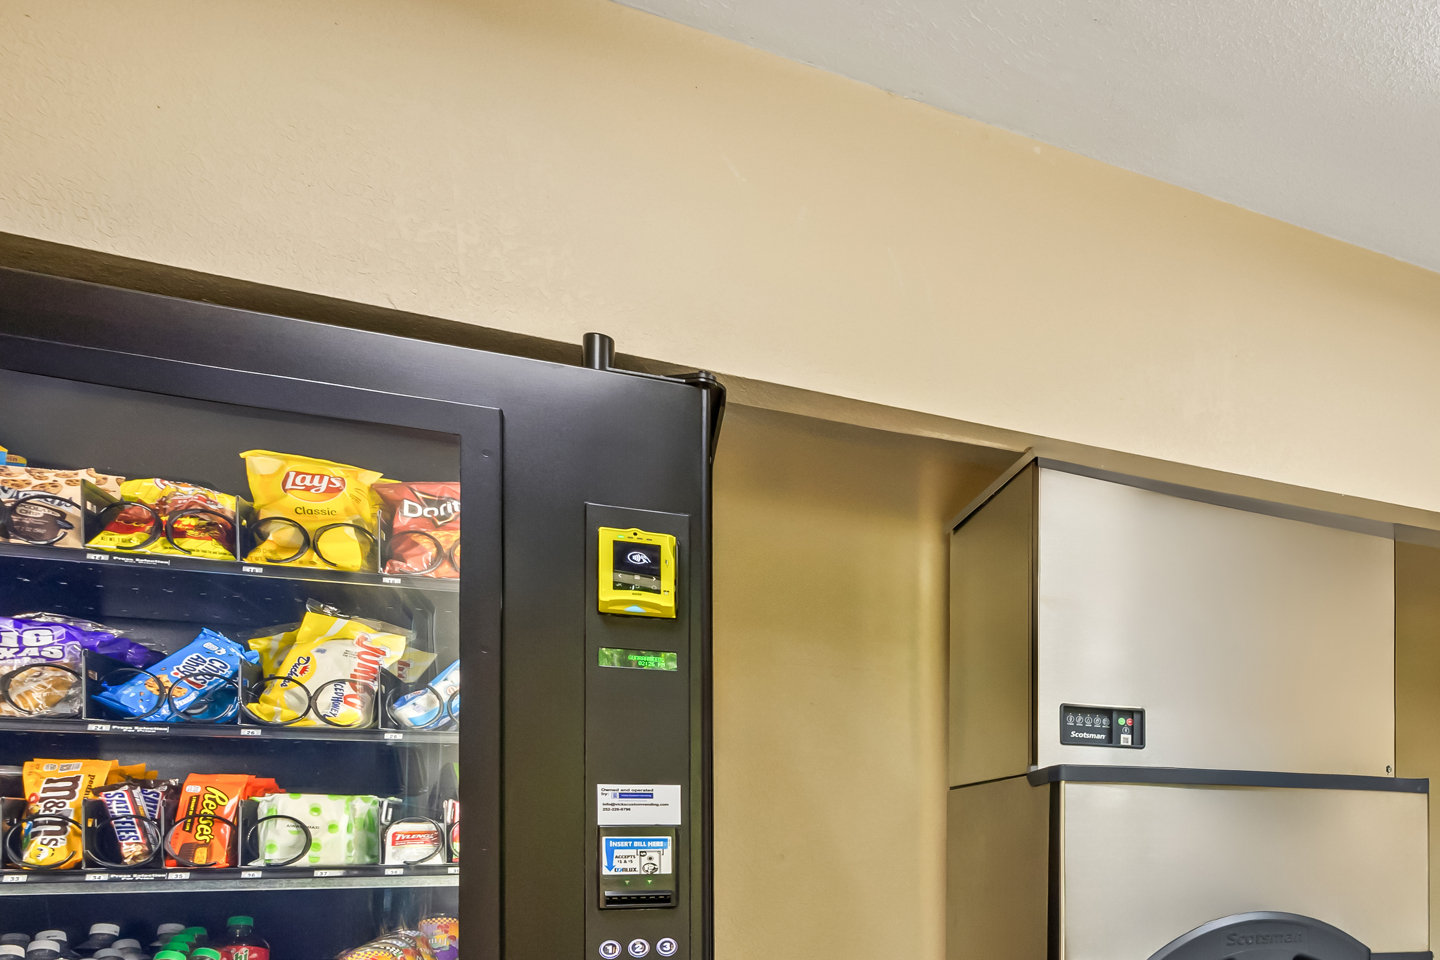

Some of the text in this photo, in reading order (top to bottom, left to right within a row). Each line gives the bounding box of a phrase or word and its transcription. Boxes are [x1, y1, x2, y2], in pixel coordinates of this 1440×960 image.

[294, 506, 337, 516] Classic
[0, 628, 54, 647] IG
[1070, 730, 1107, 740] Scotsman
[395, 833, 435, 841] TYLENOL
